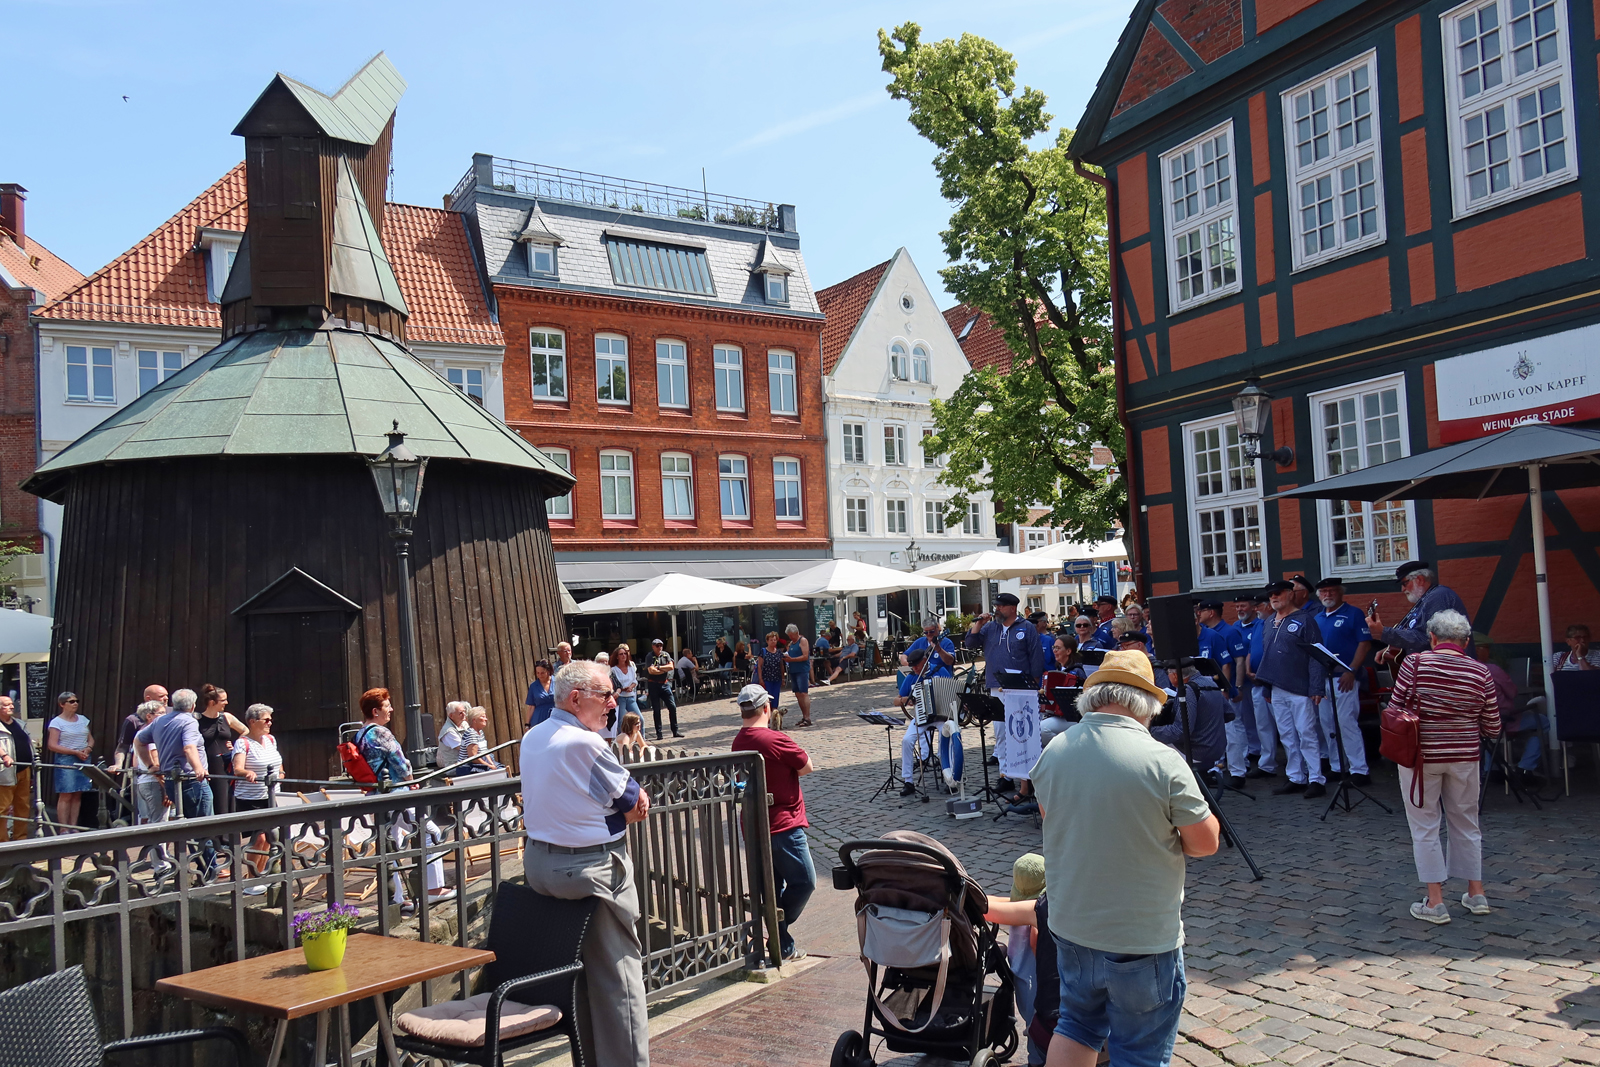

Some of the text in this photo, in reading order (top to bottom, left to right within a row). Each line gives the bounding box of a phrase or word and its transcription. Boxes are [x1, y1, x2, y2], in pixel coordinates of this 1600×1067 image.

[1468, 375, 1587, 407] LUDWIG VON KAPFF
[1542, 407, 1575, 422] STADE
[918, 553, 930, 562] VIA
